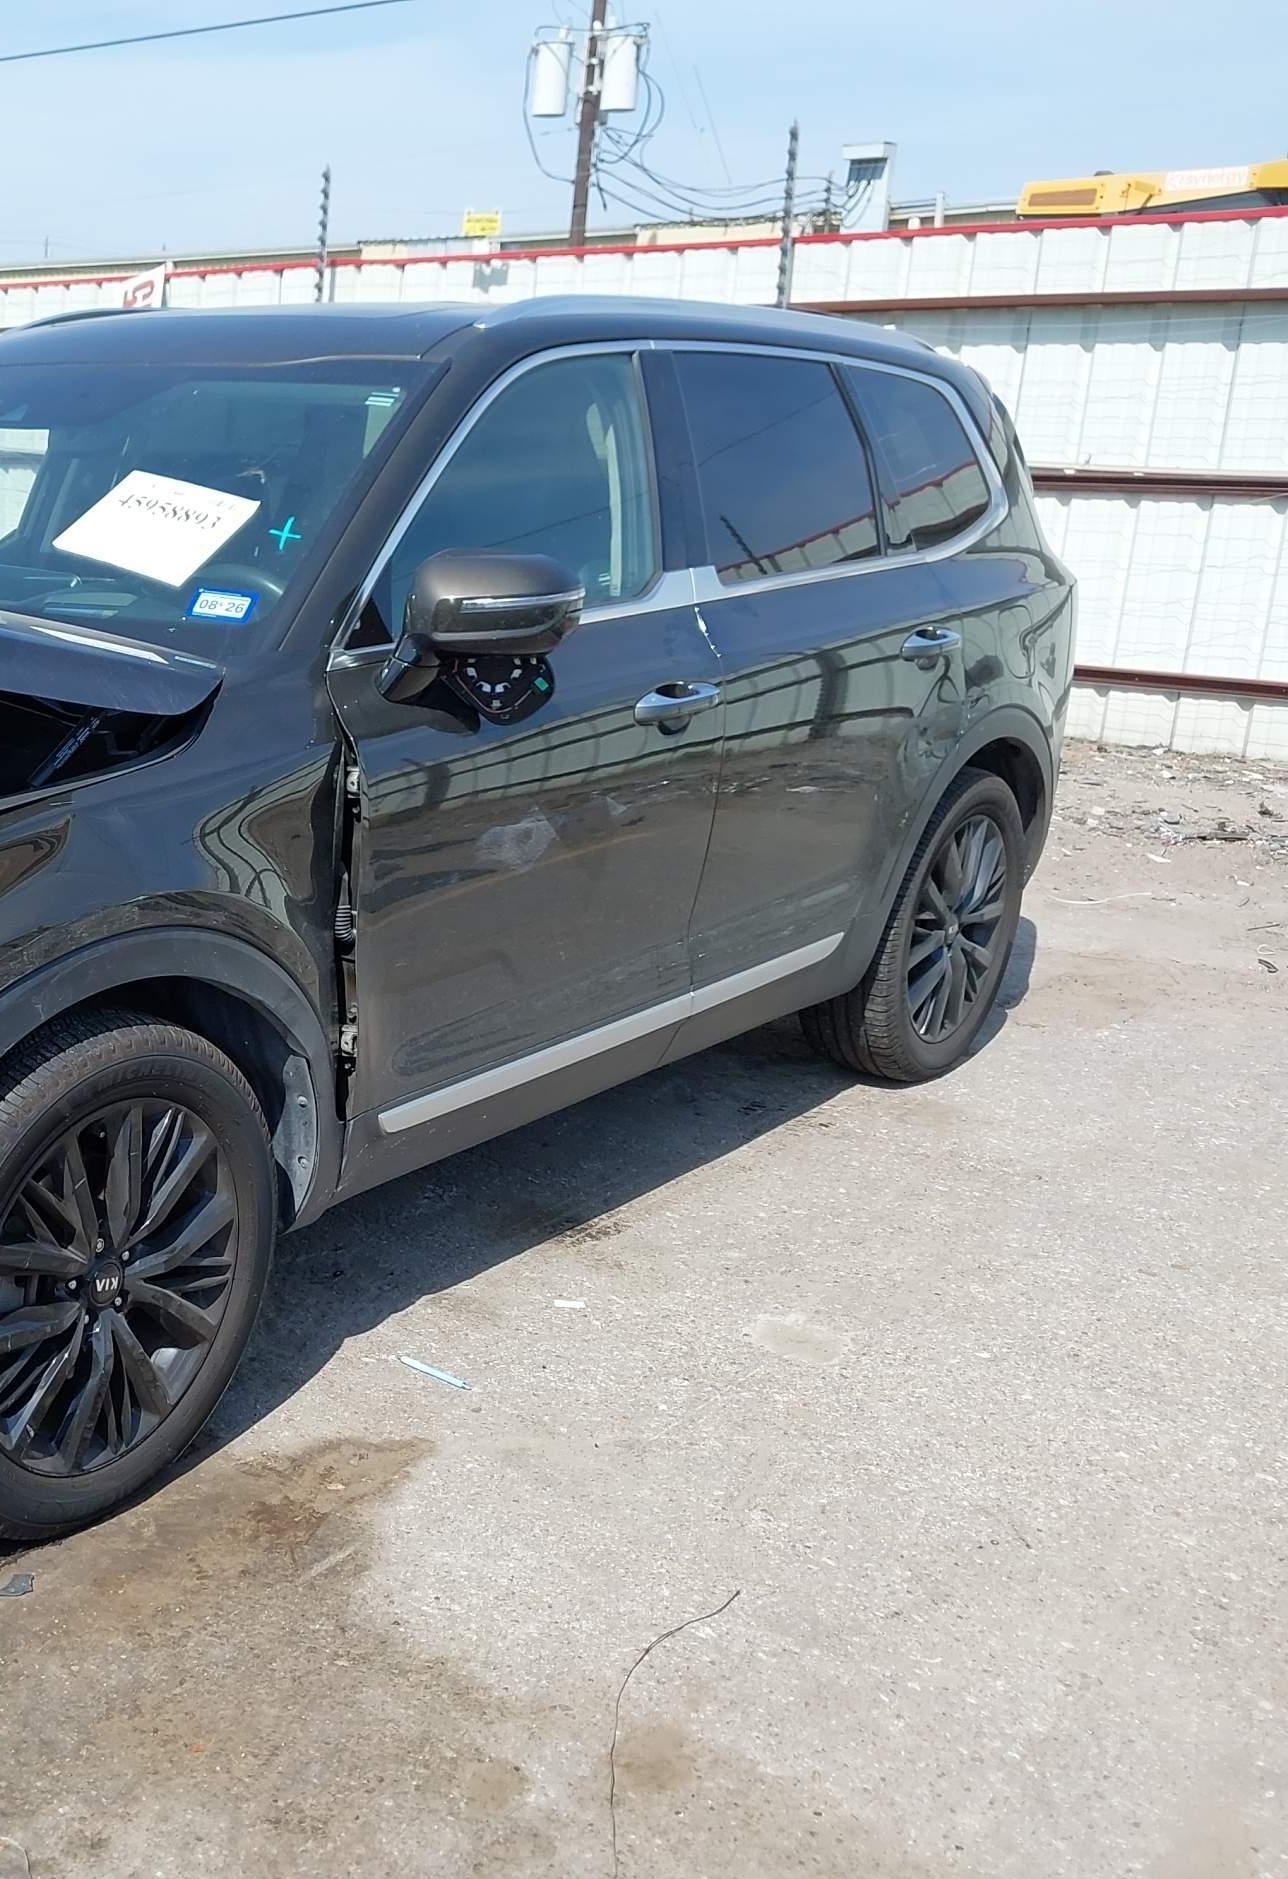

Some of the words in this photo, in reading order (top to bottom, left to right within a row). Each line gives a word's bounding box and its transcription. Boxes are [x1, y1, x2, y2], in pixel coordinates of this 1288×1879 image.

[199, 599, 218, 610] 08
[225, 602, 245, 613] 26
[95, 1276, 119, 1292] KIA
